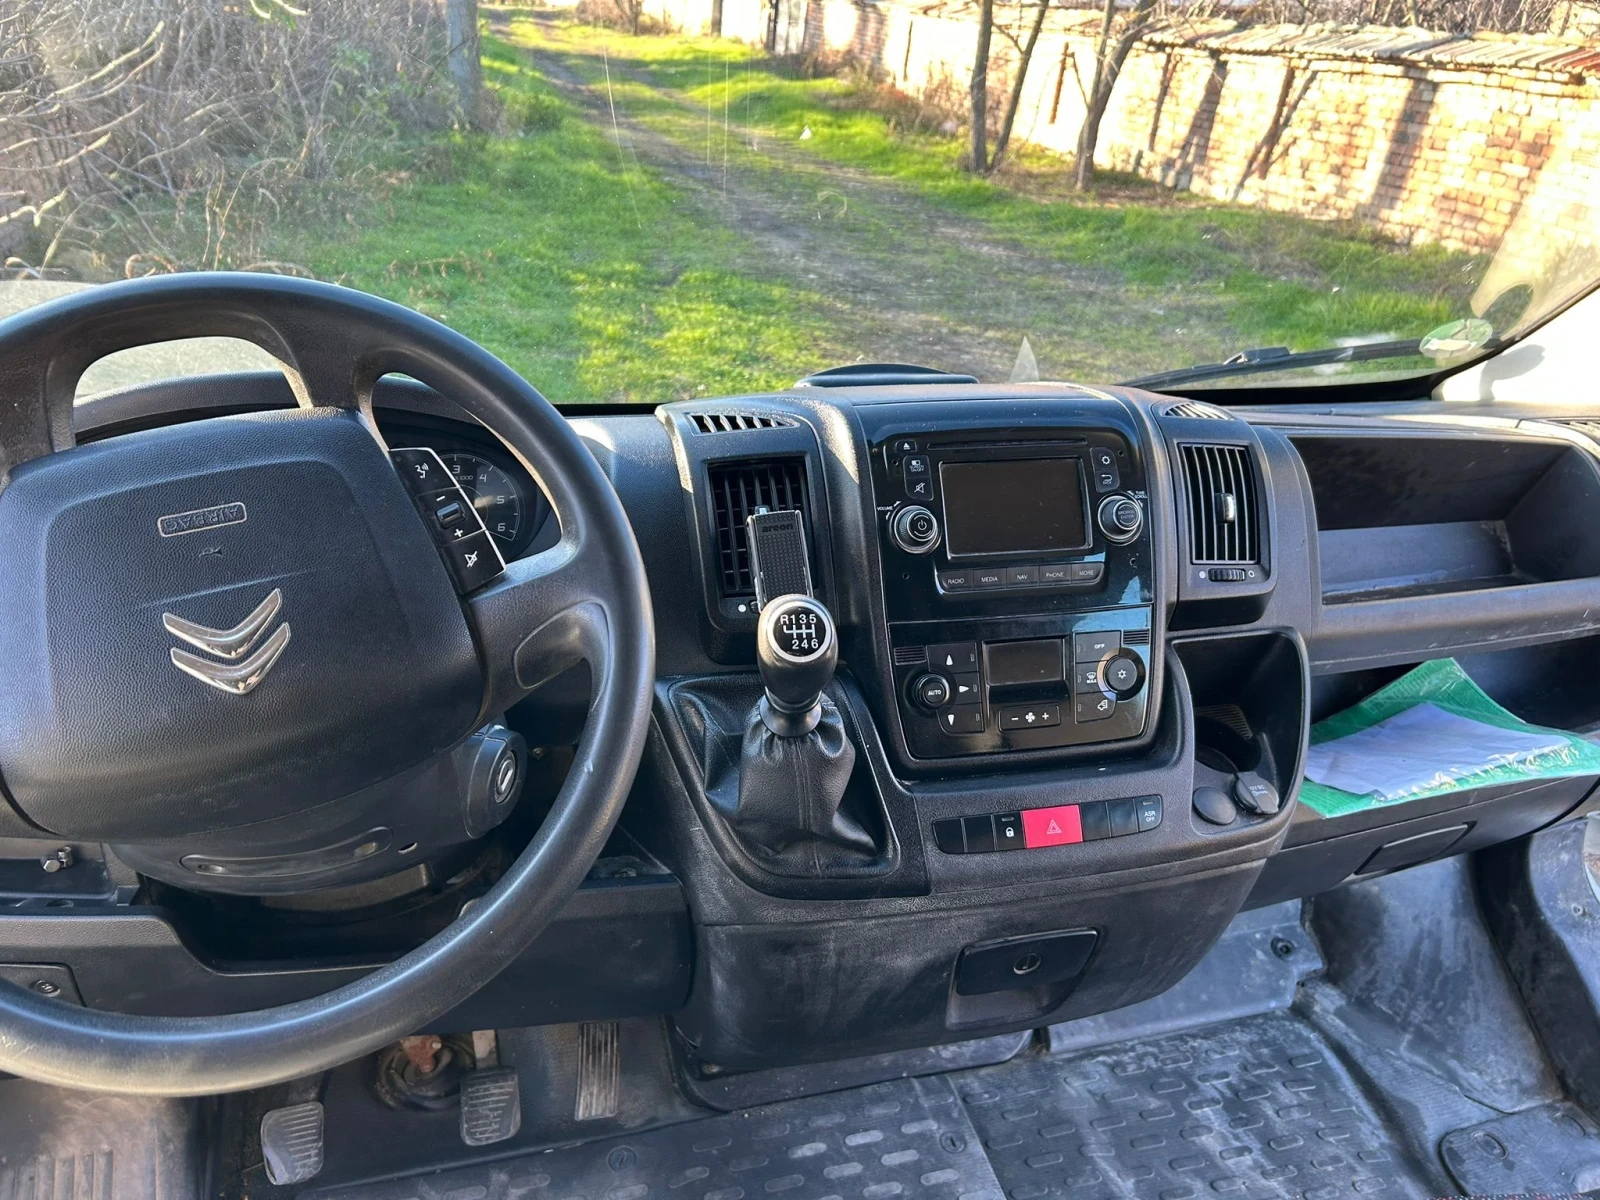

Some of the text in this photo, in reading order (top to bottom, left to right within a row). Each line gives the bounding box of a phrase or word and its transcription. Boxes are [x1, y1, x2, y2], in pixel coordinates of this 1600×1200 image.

[452, 465, 461, 474] 3
[479, 474, 487, 482] 4
[496, 495, 505, 504] 5
[164, 505, 239, 531] AIRBAG
[497, 523, 506, 531] 6
[761, 523, 794, 532] areon
[947, 577, 965, 585] RADIO
